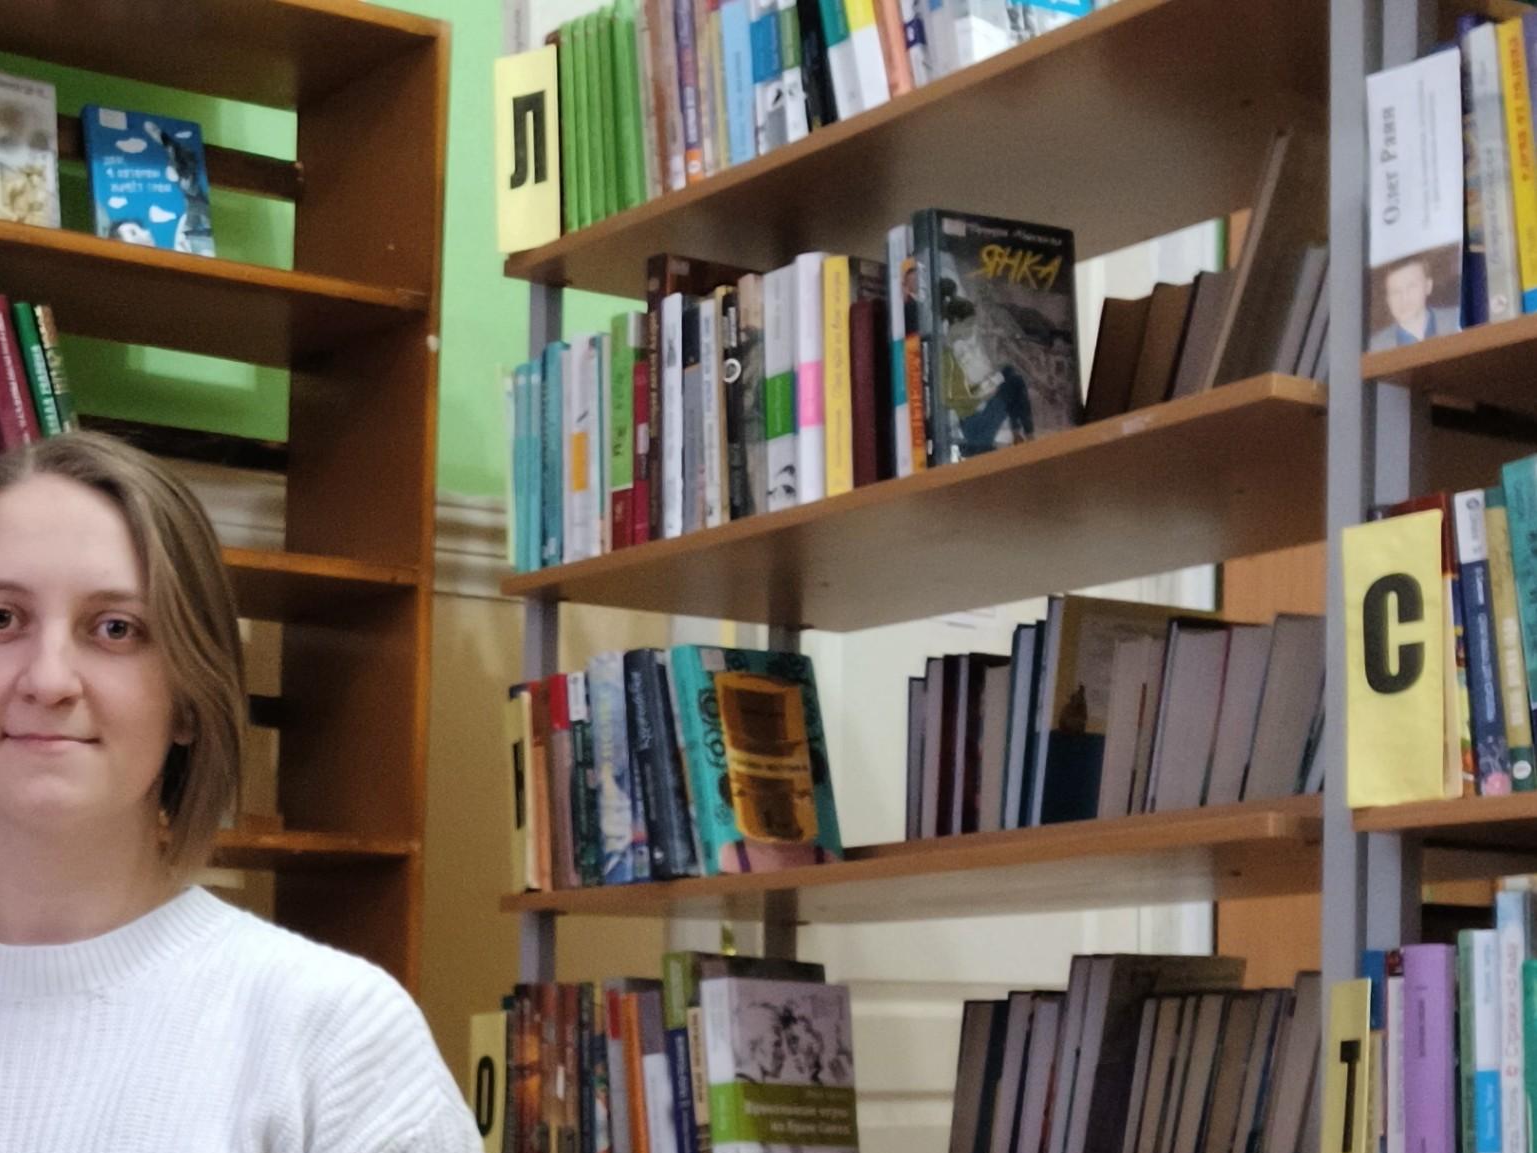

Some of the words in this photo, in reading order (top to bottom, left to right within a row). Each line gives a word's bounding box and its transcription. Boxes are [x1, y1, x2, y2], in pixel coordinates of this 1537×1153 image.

[510, 90, 546, 189] Л
[1362, 572, 1425, 695] С
[1340, 1040, 1361, 1153] Т
